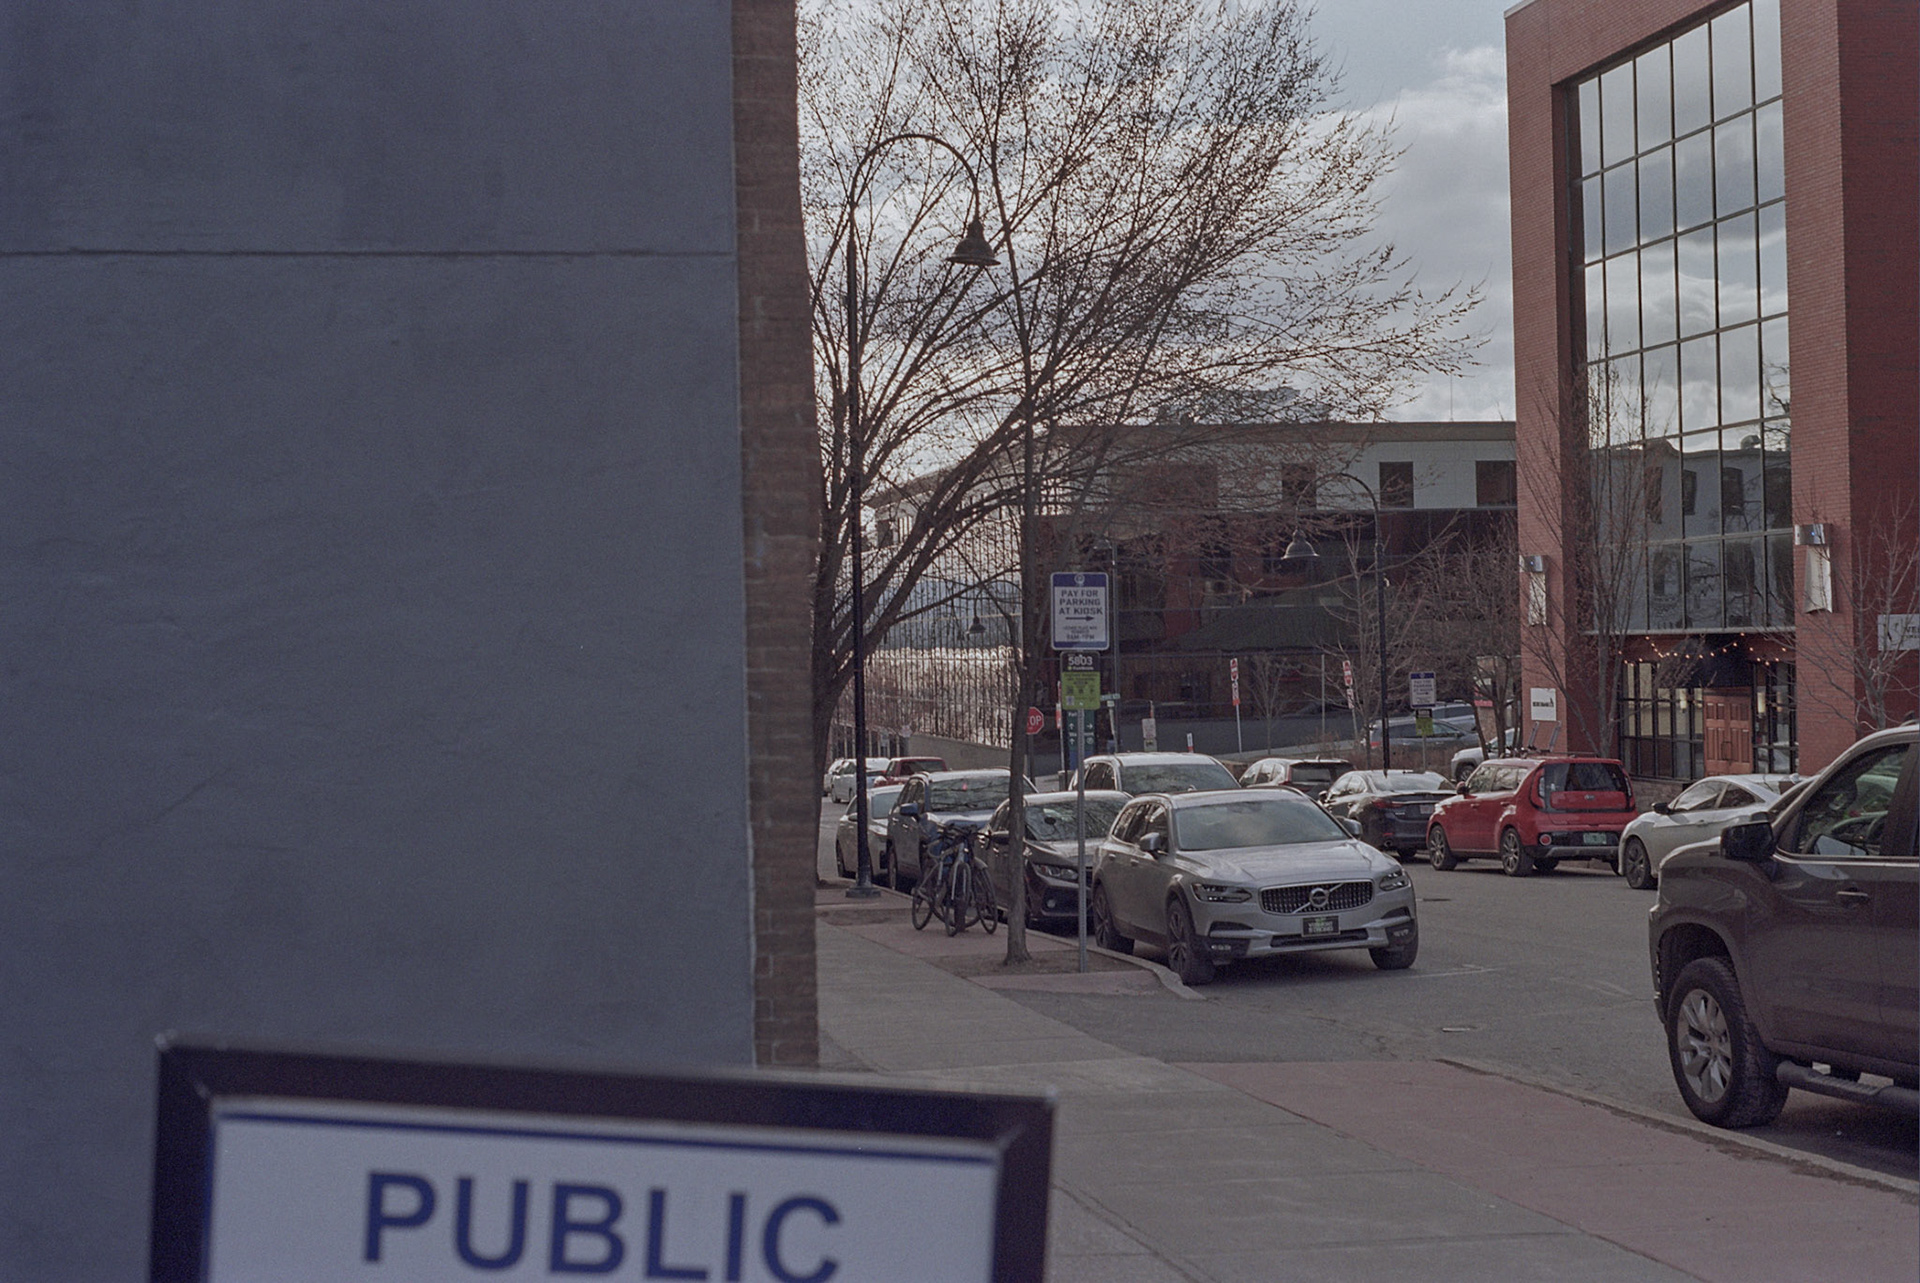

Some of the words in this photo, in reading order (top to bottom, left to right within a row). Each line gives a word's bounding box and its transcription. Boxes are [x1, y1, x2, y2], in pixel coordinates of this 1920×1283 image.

[1061, 589, 1079, 597] PAY
[1081, 589, 1099, 597] FOR
[1060, 598, 1101, 606] PARKING
[1059, 607, 1071, 615] AT
[1074, 607, 1103, 615] KIOSK
[1068, 656, 1093, 666] 5803
[365, 1171, 841, 1283] PUBLIC
